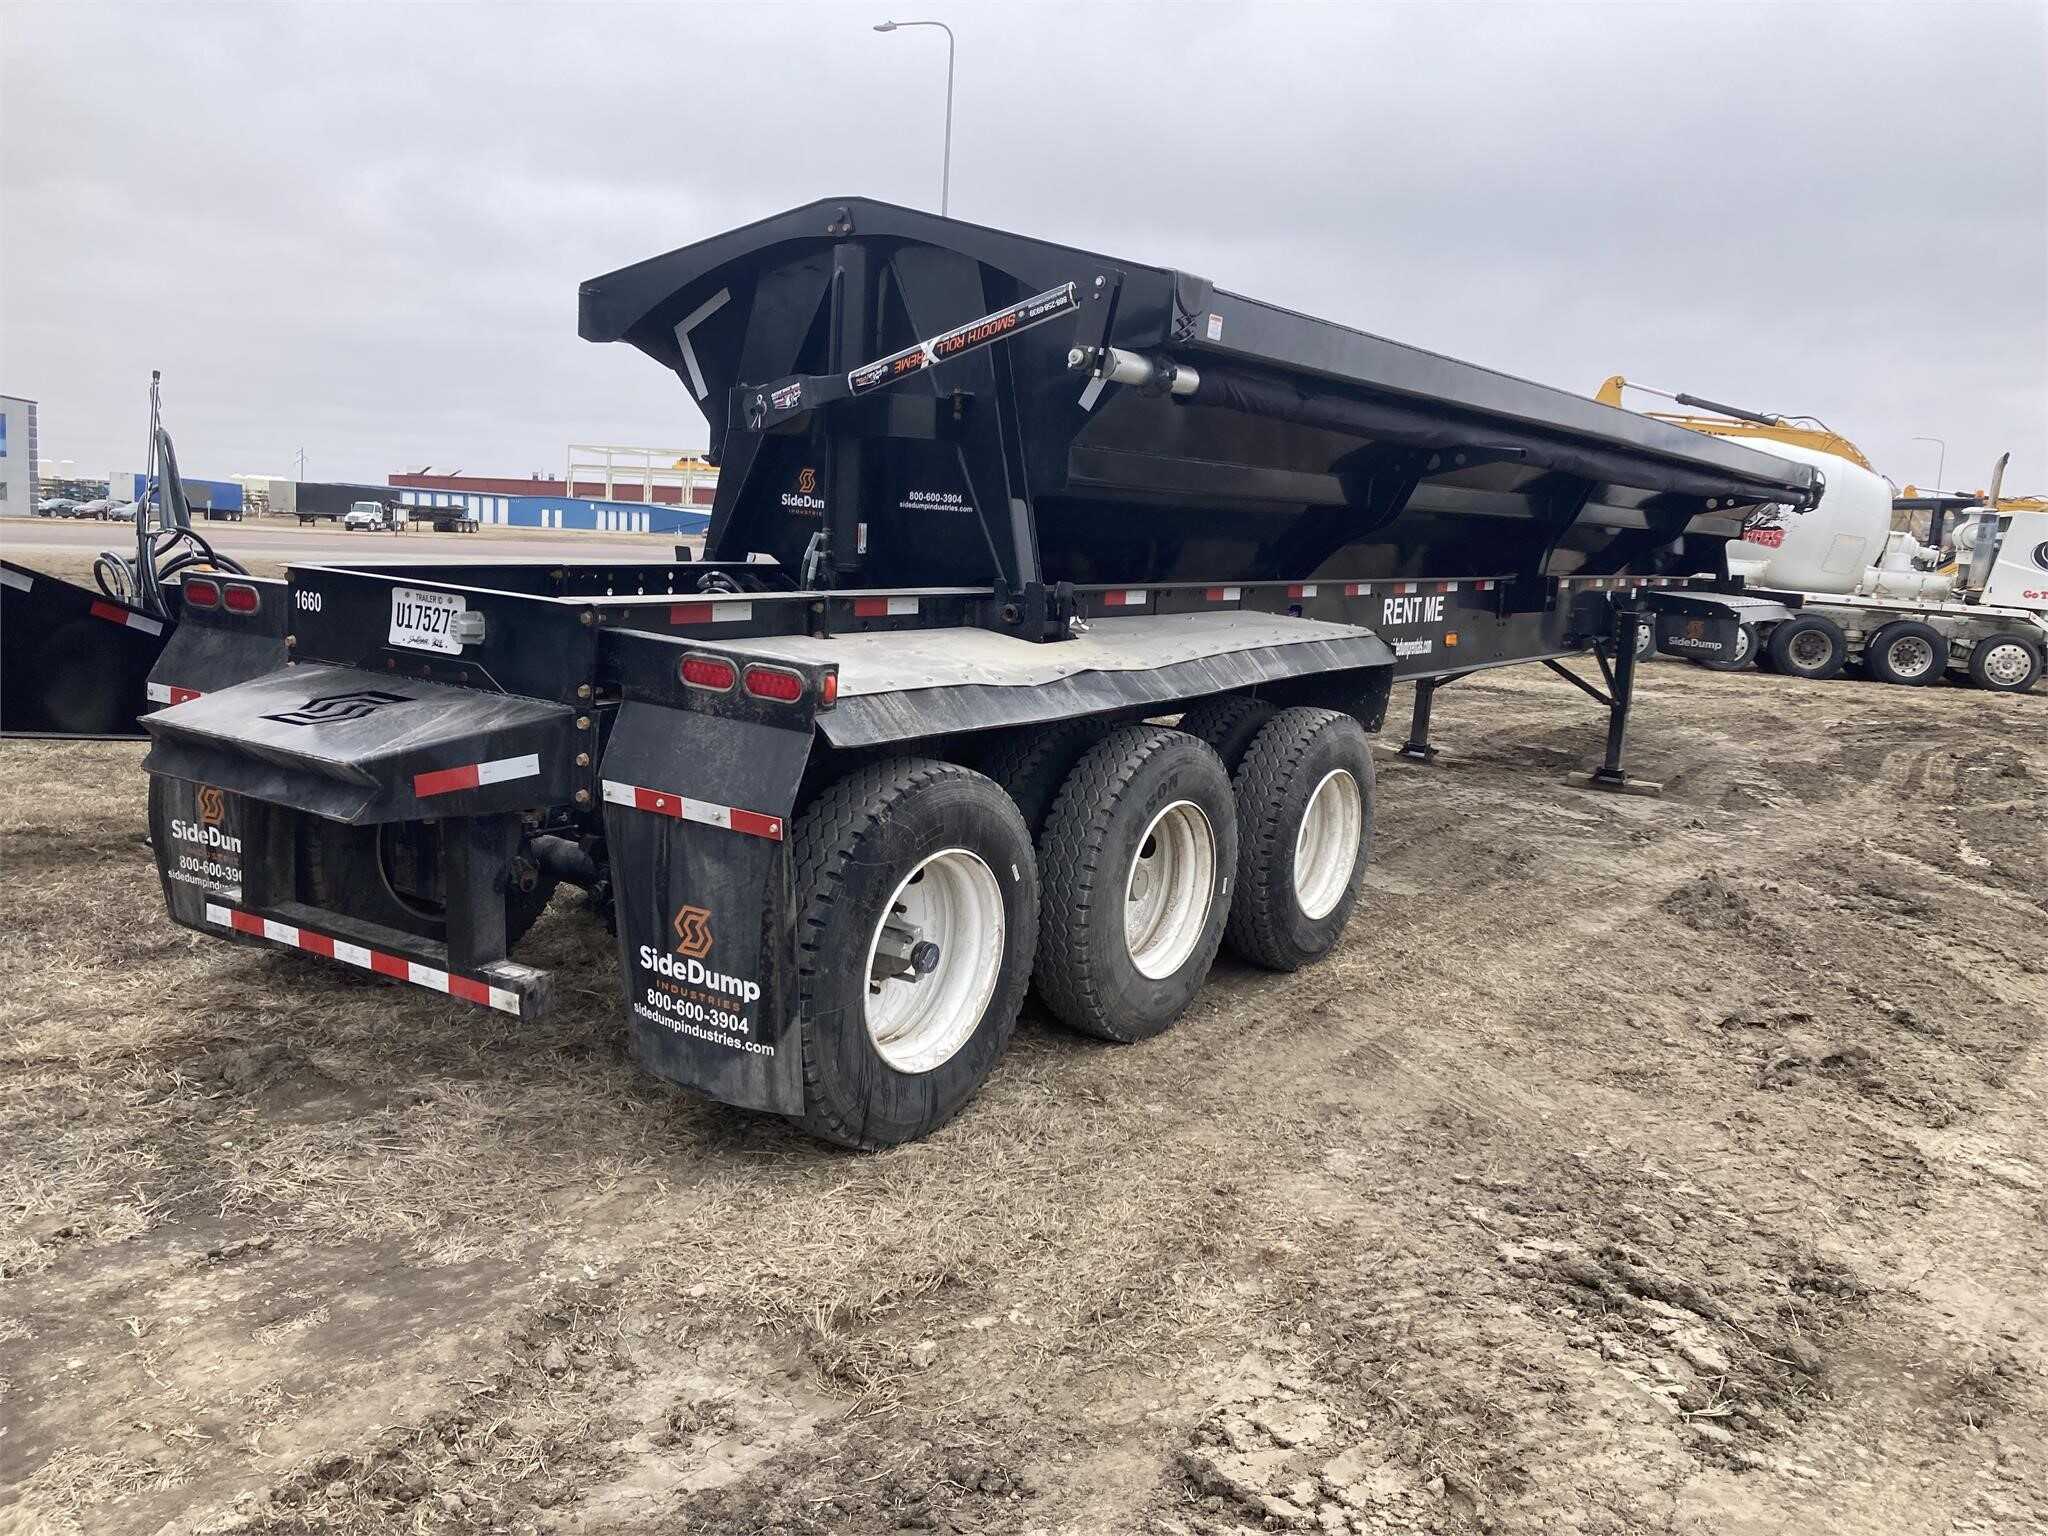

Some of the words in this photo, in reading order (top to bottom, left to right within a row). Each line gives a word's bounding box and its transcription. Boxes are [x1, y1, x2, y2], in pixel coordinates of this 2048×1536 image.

[967, 313, 1017, 343] SMOOTH
[937, 334, 966, 354] ROLL
[781, 493, 825, 509] SideDum
[899, 501, 973, 513] sidedumpindustries.com
[909, 491, 962, 504] 800-600-3904
[295, 589, 322, 613] 1660
[2023, 590, 2039, 599] Go
[1383, 597, 1422, 625] RENT
[1424, 596, 1445, 622] ME
[1668, 636, 1722, 651] SideDump
[171, 819, 242, 853] SideDum
[180, 856, 242, 882] 800-600-39
[639, 945, 761, 1004] SideDump
[656, 979, 741, 1012] INDUSTRIES
[647, 988, 750, 1035] 800-600-3904
[633, 1002, 775, 1057] sidedumpindustries.com
